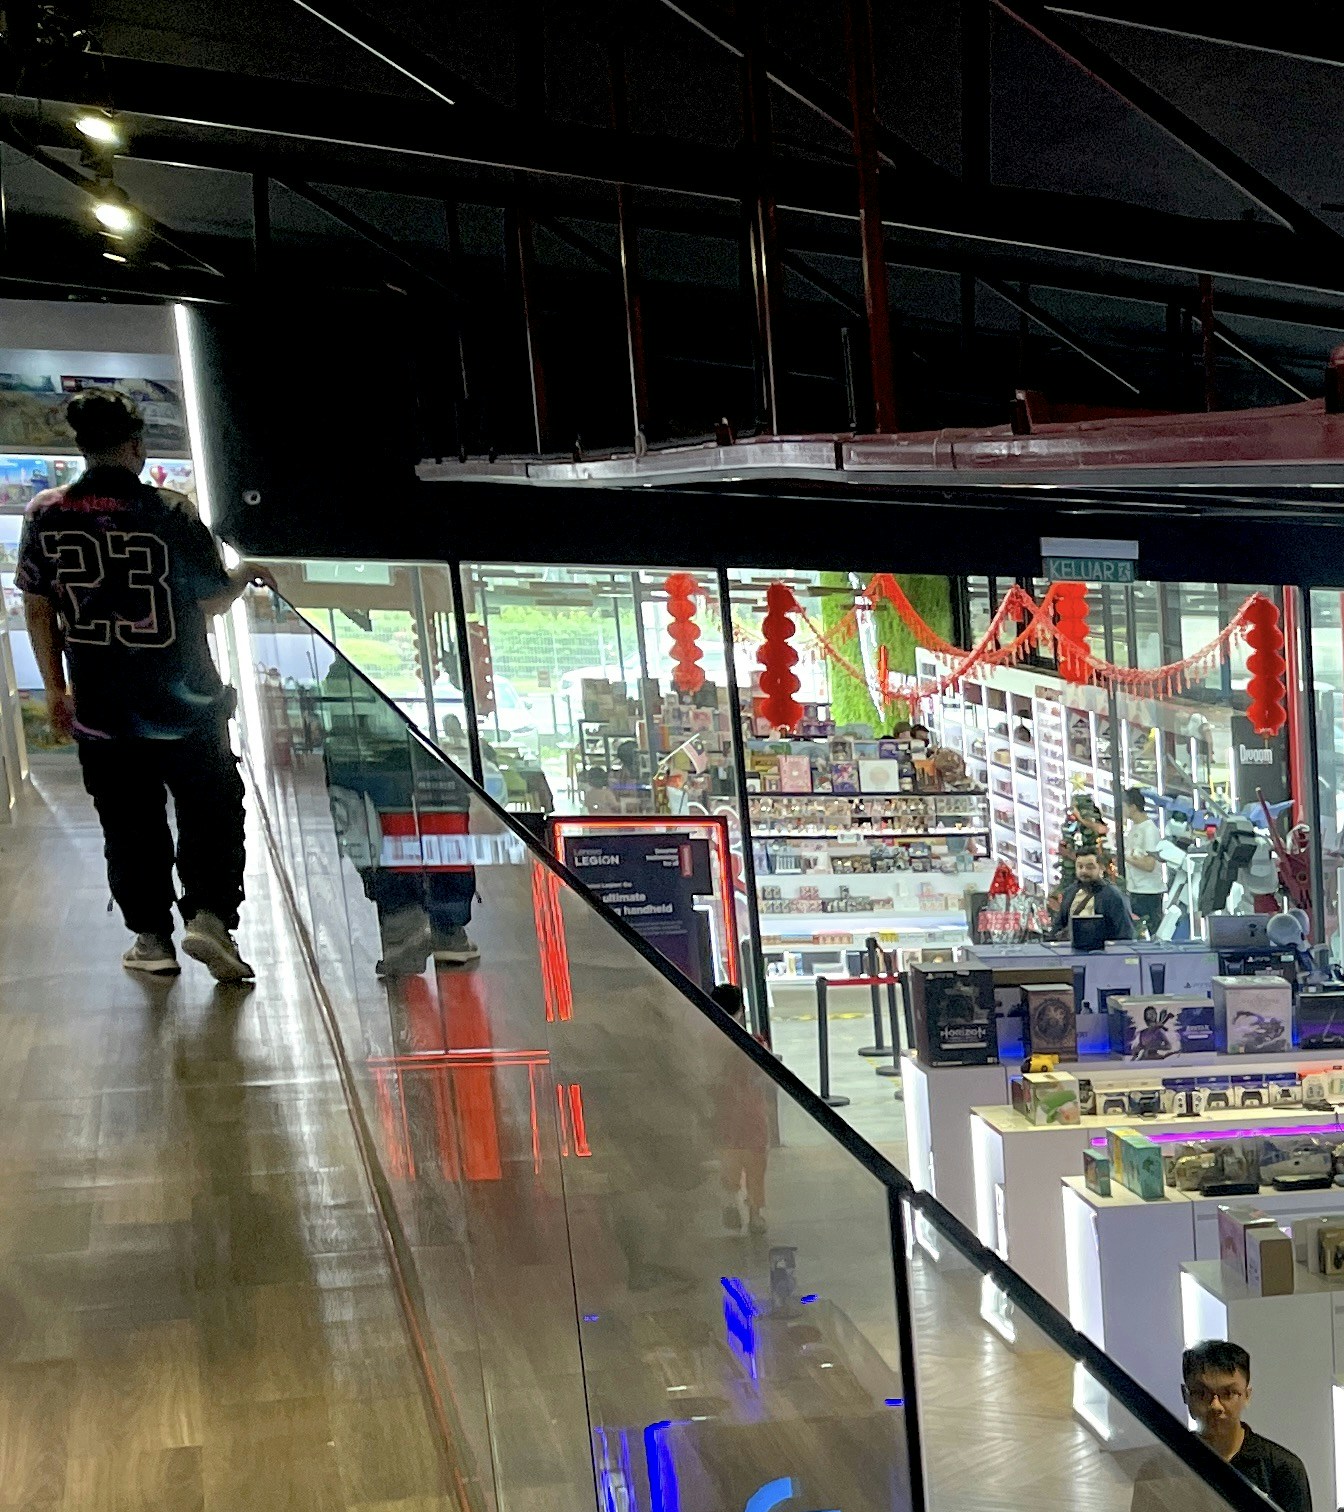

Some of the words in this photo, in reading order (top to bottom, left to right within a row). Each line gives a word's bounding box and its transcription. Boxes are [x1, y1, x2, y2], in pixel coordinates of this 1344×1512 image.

[1050, 561, 1114, 580] KELUAR
[41, 531, 177, 648] 23
[574, 855, 620, 867] LEGION
[623, 903, 673, 916] handheld
